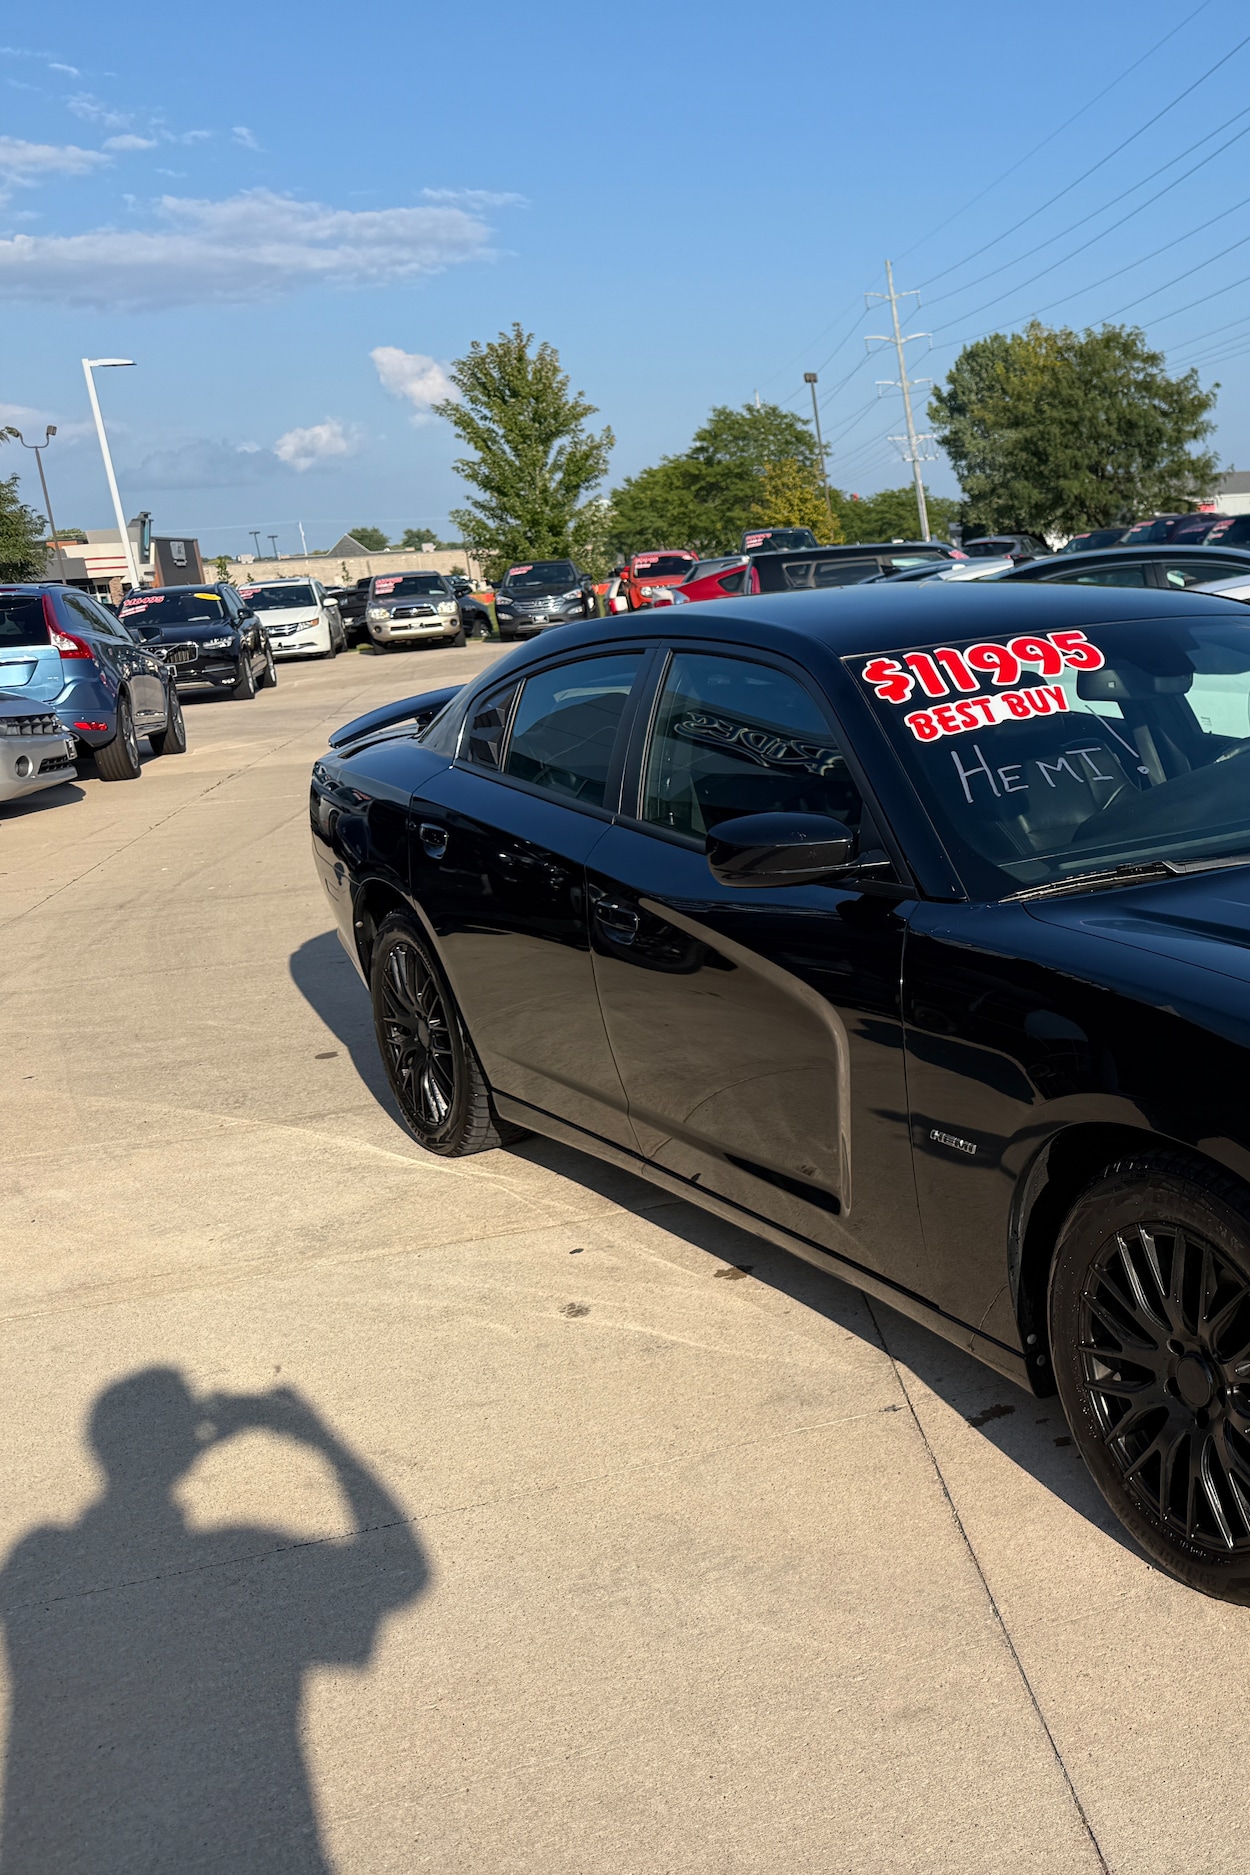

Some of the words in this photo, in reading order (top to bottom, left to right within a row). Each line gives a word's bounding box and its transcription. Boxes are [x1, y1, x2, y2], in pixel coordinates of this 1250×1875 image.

[862, 630, 1105, 704] $11995
[905, 697, 998, 742] BEST
[1001, 684, 1070, 719] BUY
